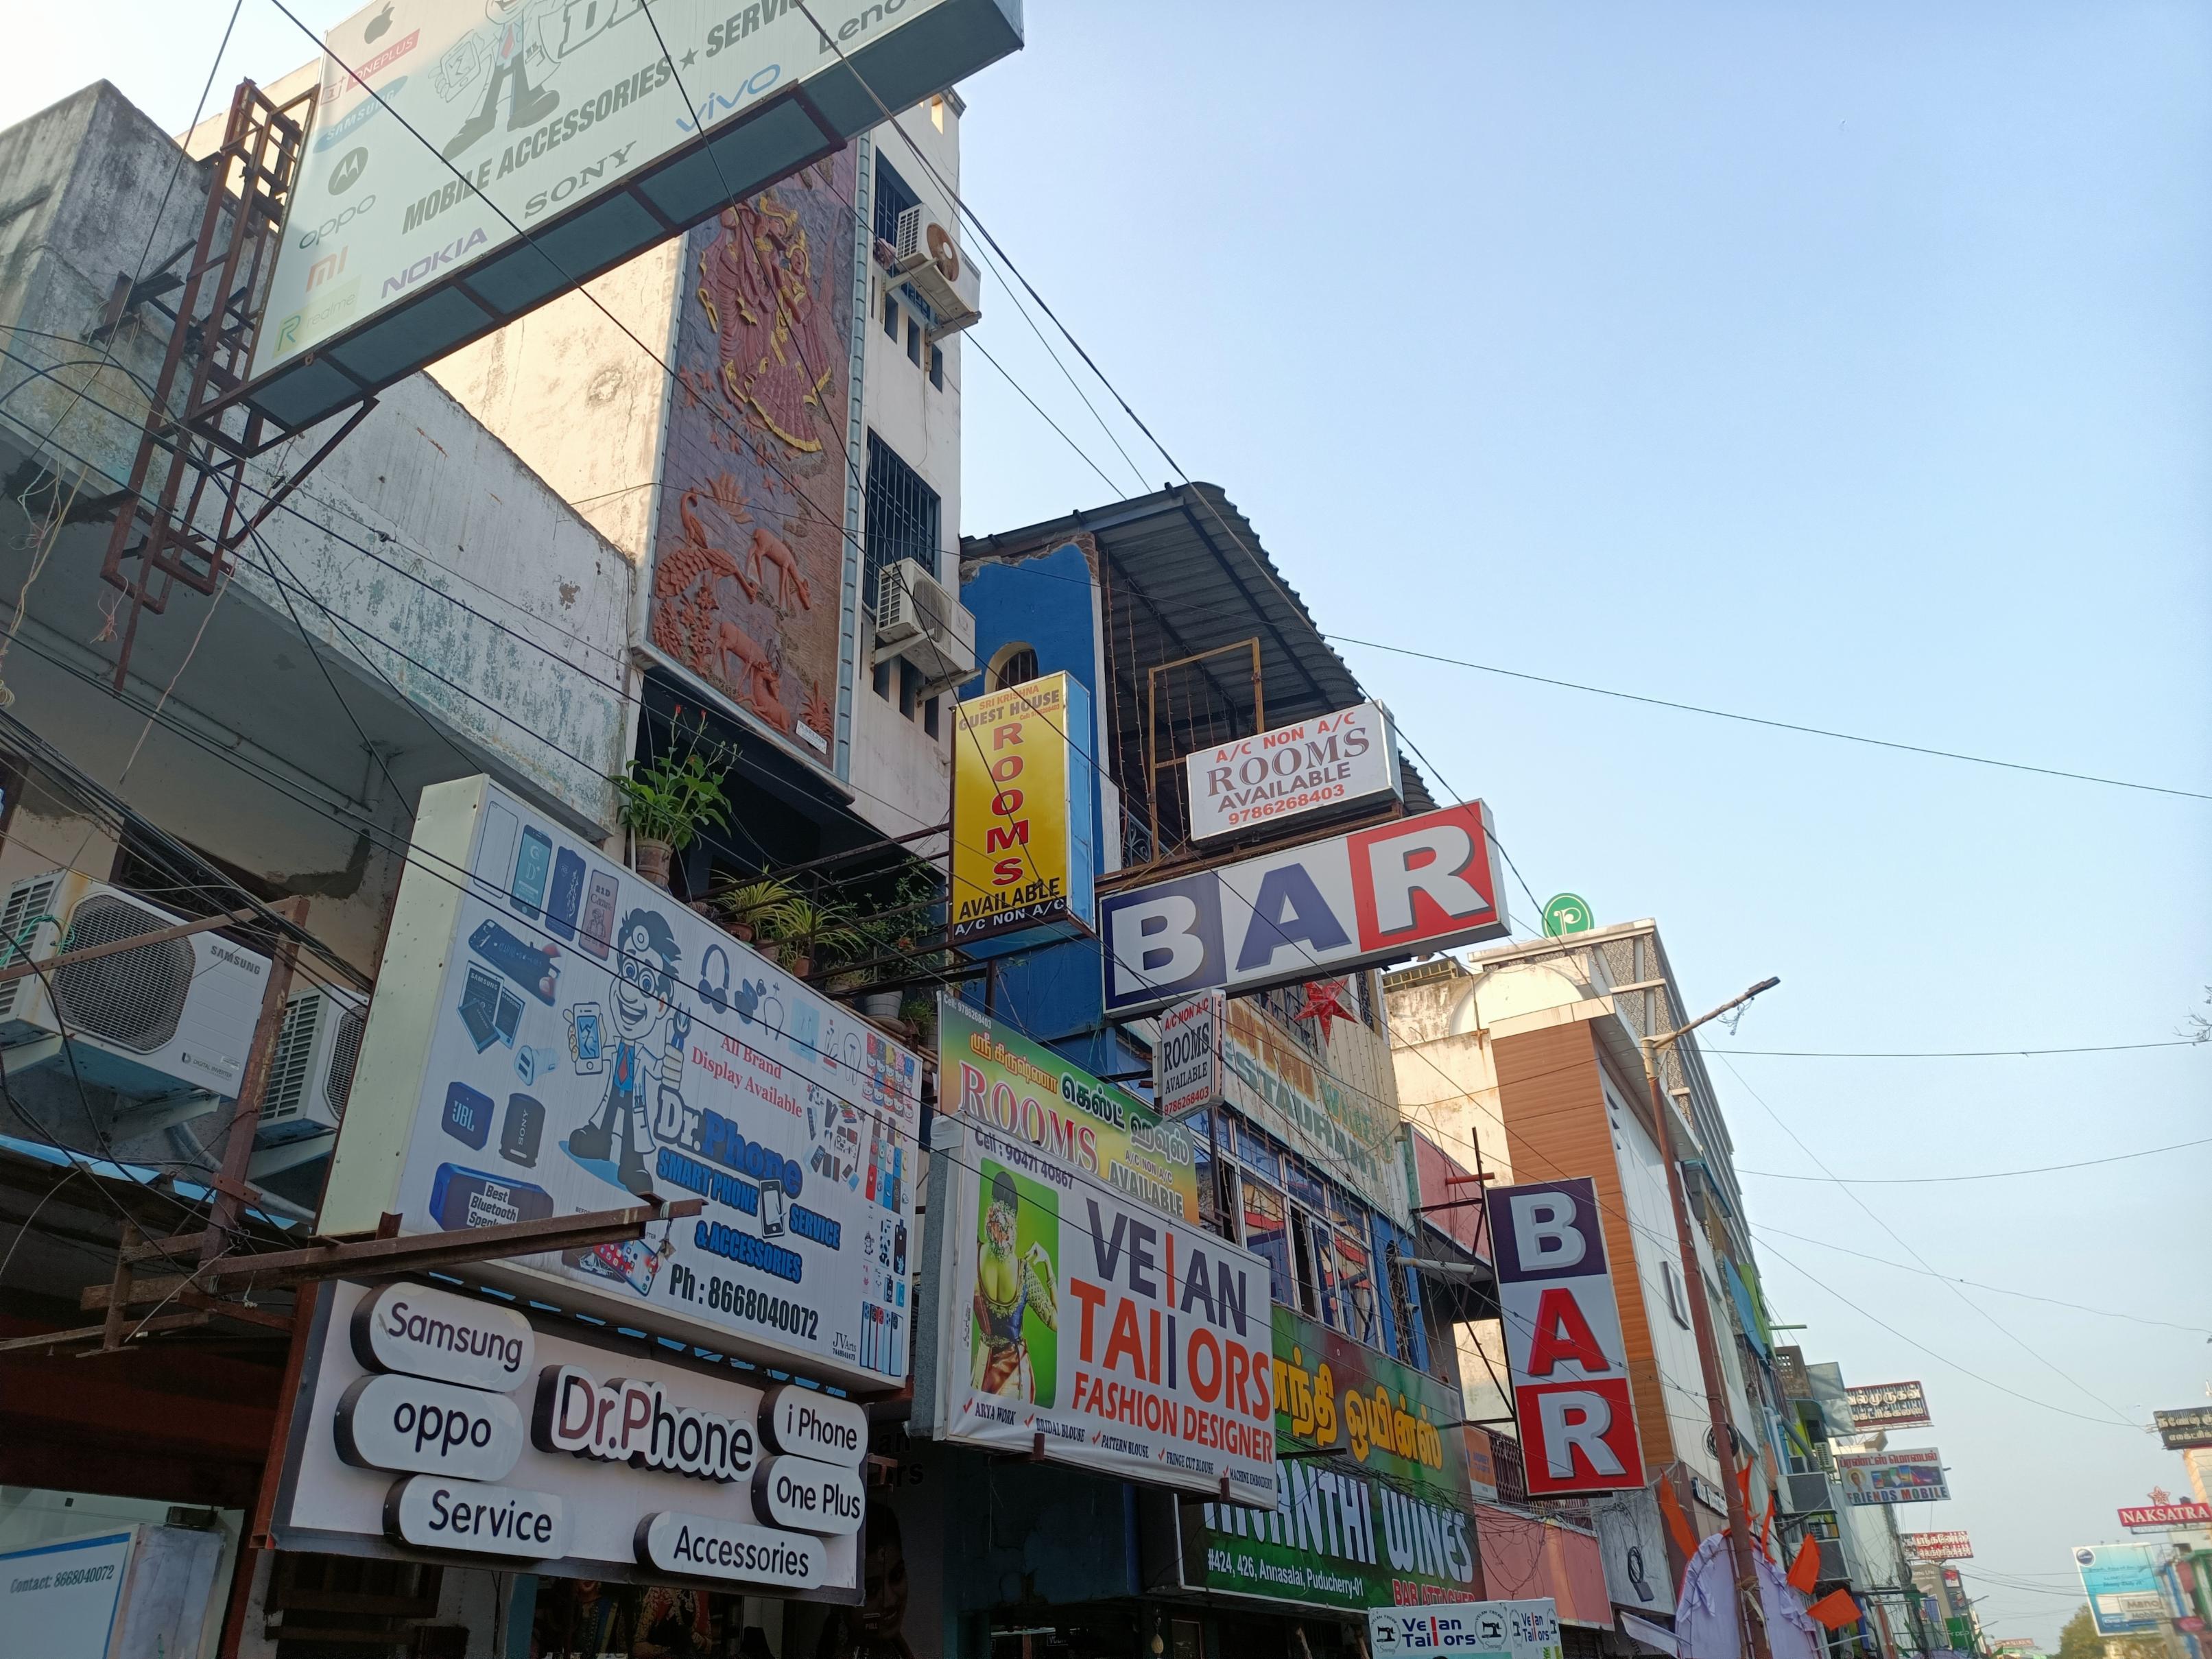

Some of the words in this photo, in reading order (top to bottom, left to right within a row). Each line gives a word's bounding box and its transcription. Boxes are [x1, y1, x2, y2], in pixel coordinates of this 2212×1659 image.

[353, 37, 413, 82] ONEPLUS
[326, 89, 394, 141] SAMSUNG
[381, 228, 488, 298] NOKIA
[525, 141, 637, 219] SONY
[676, 64, 781, 132] vivo
[820, 0, 916, 55] Leno
[403, 158, 492, 234] MOBILE
[497, 55, 671, 180] ACCESSORIES
[300, 195, 376, 249] oppo
[306, 291, 355, 328] realme
[959, 706, 1005, 732] GUEST
[1010, 689, 1060, 717] HOUSE
[979, 700, 995, 711] SRI
[997, 685, 1040, 705] KRISHNA
[1215, 741, 1252, 764] A/C
[1263, 727, 1304, 748] NON
[1318, 712, 1355, 733] A/C
[1206, 728, 1370, 796] ROOMS
[986, 721, 1030, 886] ROOMS
[1218, 762, 1351, 813] AVAILABLE
[1228, 784, 1345, 825] 9786268403
[955, 919, 986, 936] A/C
[993, 909, 1025, 927] NON
[1032, 898, 1065, 917] A/C
[959, 877, 1060, 920] AVAILABLE
[1111, 824, 1492, 996] BAR
[211, 945, 261, 975] SAMSUNG
[471, 972, 498, 991] SAMSUNG
[958, 1002, 992, 1029] 9786268403
[1165, 1014, 1178, 1031] A/C
[1178, 1004, 1195, 1025] NON
[1196, 996, 1209, 1015] A/C
[193, 1059, 211, 1071] DIGITAL
[211, 1066, 233, 1077] INVERTER
[720, 1034, 741, 1057] All
[742, 1045, 782, 1080] Brand
[1163, 1021, 1211, 1073] ROOMS
[691, 1046, 743, 1092] Display
[745, 1070, 803, 1119] Available
[1165, 1062, 1209, 1095] AVAILABLE
[452, 1100, 475, 1132] JBL
[960, 1059, 1098, 1175] ROOMS
[1164, 1086, 1210, 1117] 9786268403
[517, 1109, 528, 1146] SONY
[655, 1088, 803, 1200] Dr.Phone
[1040, 1162, 1075, 1191] 40867
[1125, 1149, 1140, 1165] A/C
[1141, 1156, 1157, 1173] NON
[1158, 1166, 1173, 1184] A/C
[471, 1196, 516, 1222] Bluetooth
[486, 1185, 508, 1203] Best
[656, 1146, 709, 1200] SMART
[710, 1167, 760, 1216] PHONE
[788, 1202, 841, 1251] SERVICE
[1108, 1159, 1185, 1219] AVAILABLE
[694, 1219, 709, 1248] &
[709, 1226, 802, 1284] ACCESSORIES
[709, 1277, 820, 1341] 8668040072
[388, 1302, 523, 1372] Samsung
[1509, 1191, 1628, 1479] BAR
[394, 1402, 492, 1456] oppo
[558, 1374, 754, 1473] Dr.Phone
[798, 1409, 857, 1451] Phone
[975, 1402, 995, 1420] ARYA
[997, 1407, 1016, 1425] WORK
[1036, 1417, 1061, 1436] BRIDAL
[1061, 1424, 1086, 1443] BLOUSE
[1071, 1372, 1178, 1436] FASHION
[1182, 1405, 1274, 1464] DESIGNER
[1101, 1435, 1128, 1454] PATTERN
[1128, 1440, 1149, 1459] BLOUSE
[1166, 1451, 1185, 1468] FRINGE
[1186, 1455, 1196, 1470] CUT
[1195, 1458, 1214, 1475] BLOUSE
[777, 1476, 816, 1510] One
[823, 1483, 861, 1518] Plus
[1230, 1468, 1250, 1484] MACHINE
[1846, 1489, 1898, 1504] FRIENDS
[1901, 1486, 1949, 1501] MOBILE
[429, 1490, 553, 1543] Service
[1380, 1487, 1474, 1584] WINES
[2121, 1506, 2211, 1524] NAKSATRA
[674, 1526, 809, 1578] Accessories
[10, 1575, 51, 1595] Contact:
[54, 1564, 115, 1589] 8668040072
[1207, 1548, 1235, 1578] #424,
[1237, 1554, 1257, 1582] 426,
[1259, 1559, 1306, 1590] Annasalai,
[1307, 1568, 1364, 1600] Puducherry-01
[1392, 1578, 1420, 1607] BAR
